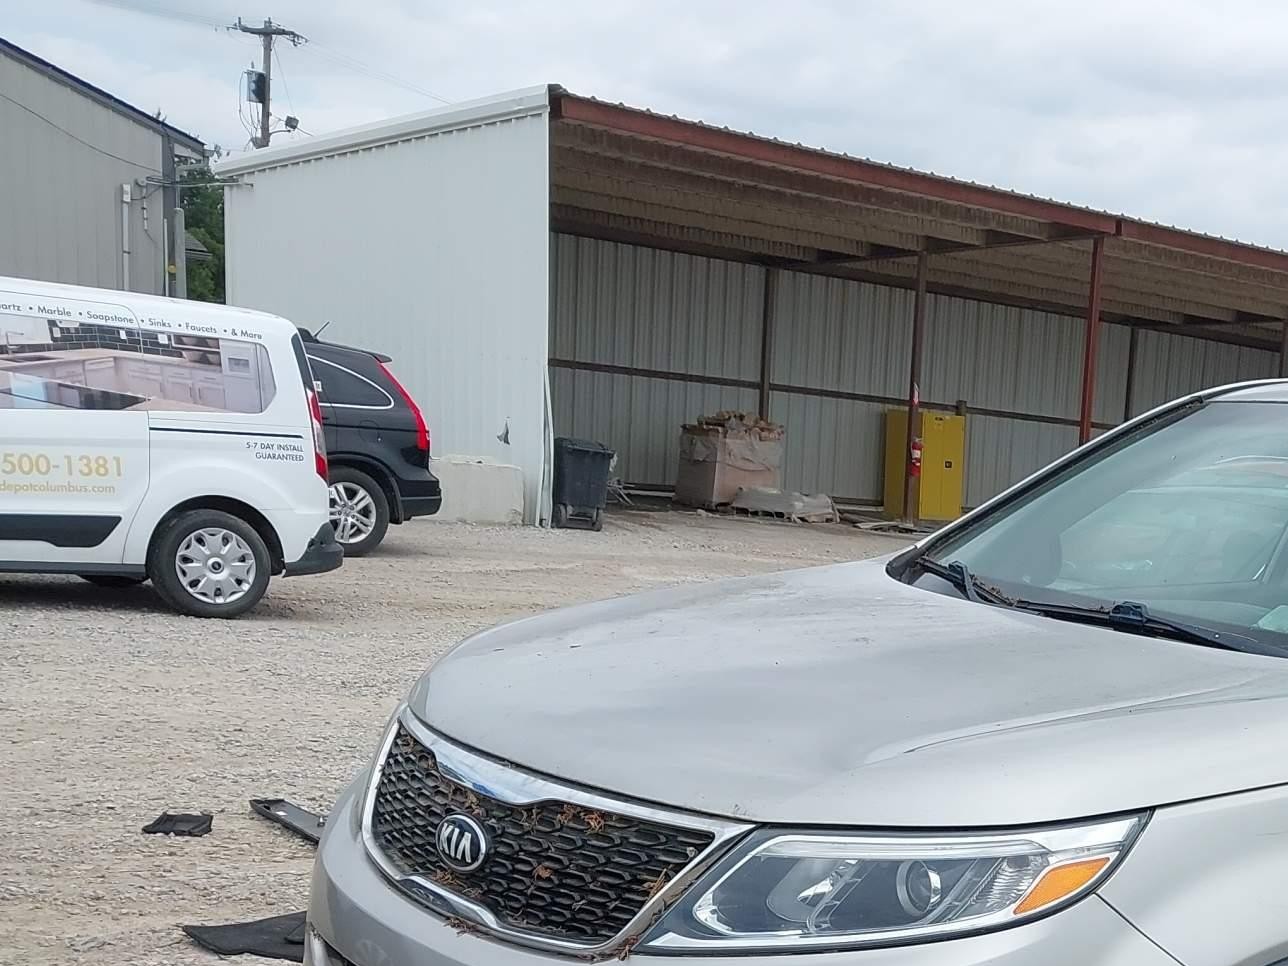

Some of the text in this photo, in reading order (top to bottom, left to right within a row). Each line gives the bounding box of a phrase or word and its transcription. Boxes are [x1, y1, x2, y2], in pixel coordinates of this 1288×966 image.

[37, 305, 72, 316] Marble
[86, 310, 134, 324] Soapstone
[148, 318, 172, 328] Sinks
[185, 322, 218, 334] Faucets
[231, 328, 238, 336] &
[240, 329, 262, 340] More
[245, 441, 304, 453] 5-7 DAY INSTALL
[255, 451, 304, 462] GUARANTEED
[1, 452, 122, 478] 500-1381
[439, 822, 472, 863] KIA
